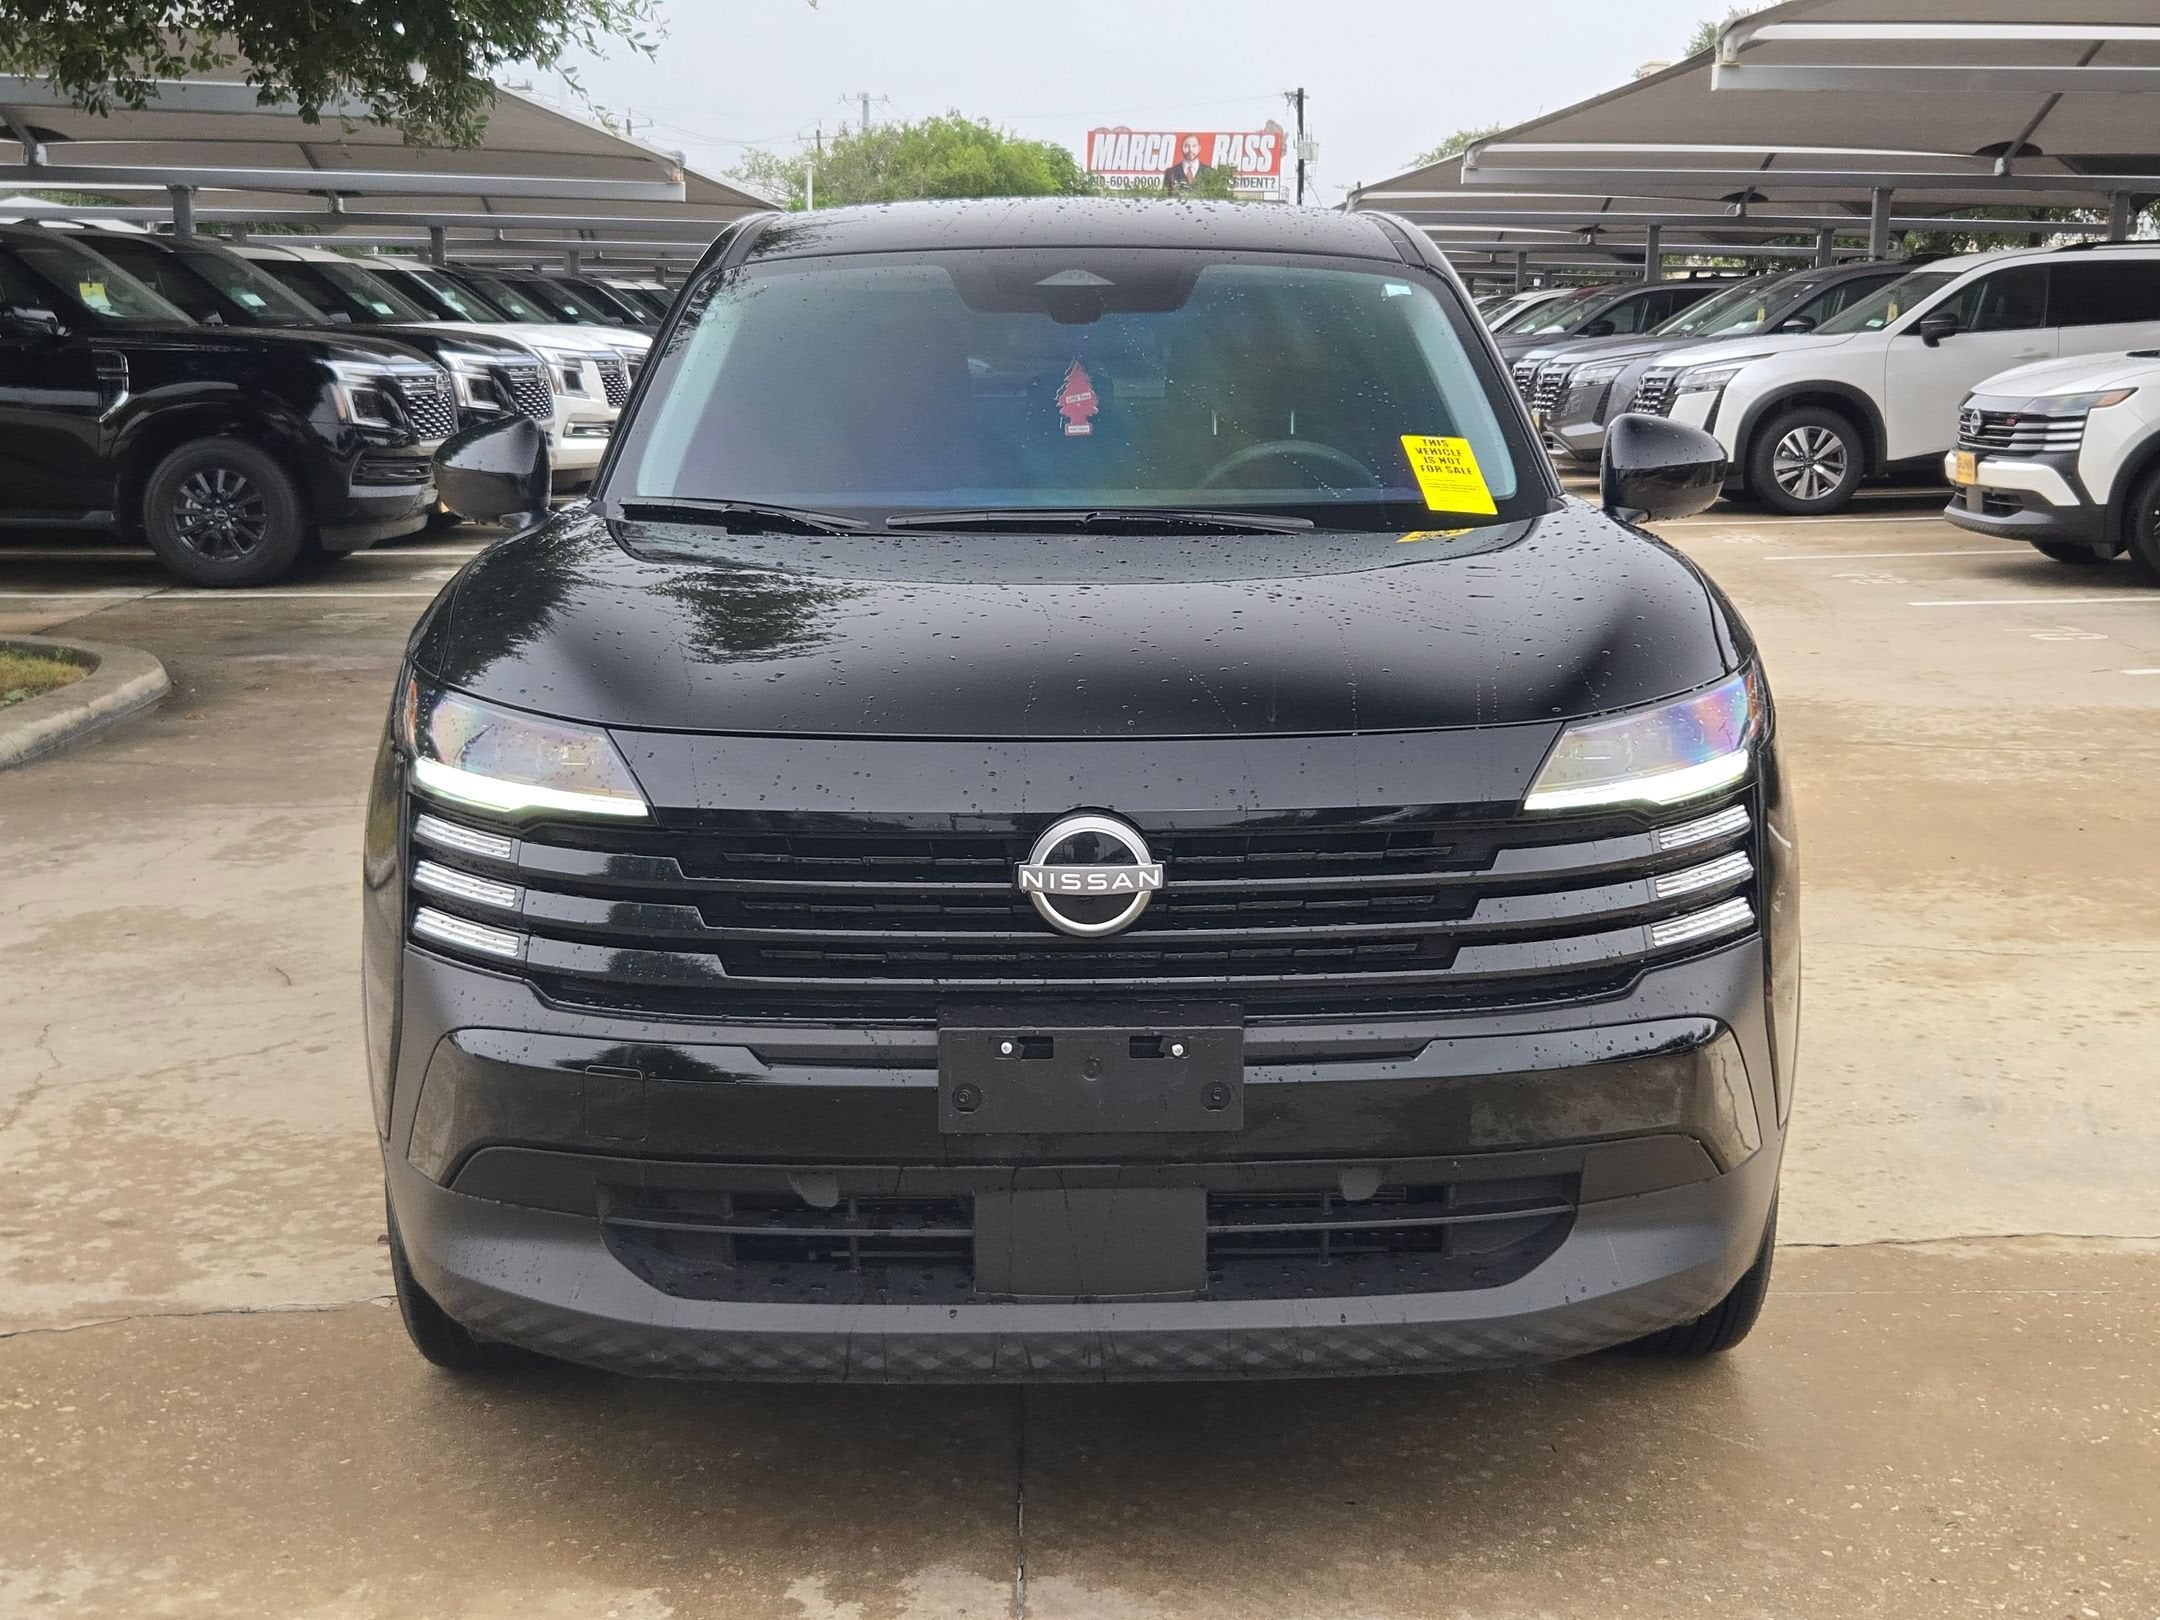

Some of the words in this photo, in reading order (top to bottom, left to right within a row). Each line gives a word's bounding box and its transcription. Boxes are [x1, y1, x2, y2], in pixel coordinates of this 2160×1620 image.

[1091, 134, 1177, 171] MARCO
[1422, 439, 1449, 447] THIS
[1415, 447, 1463, 456] VEHICLE
[1423, 456, 1436, 464] IS
[1438, 457, 1461, 465] NOT
[1420, 465, 1443, 473] FOR
[1445, 465, 1473, 475] SALE
[1022, 869, 1159, 890] NISSAN
